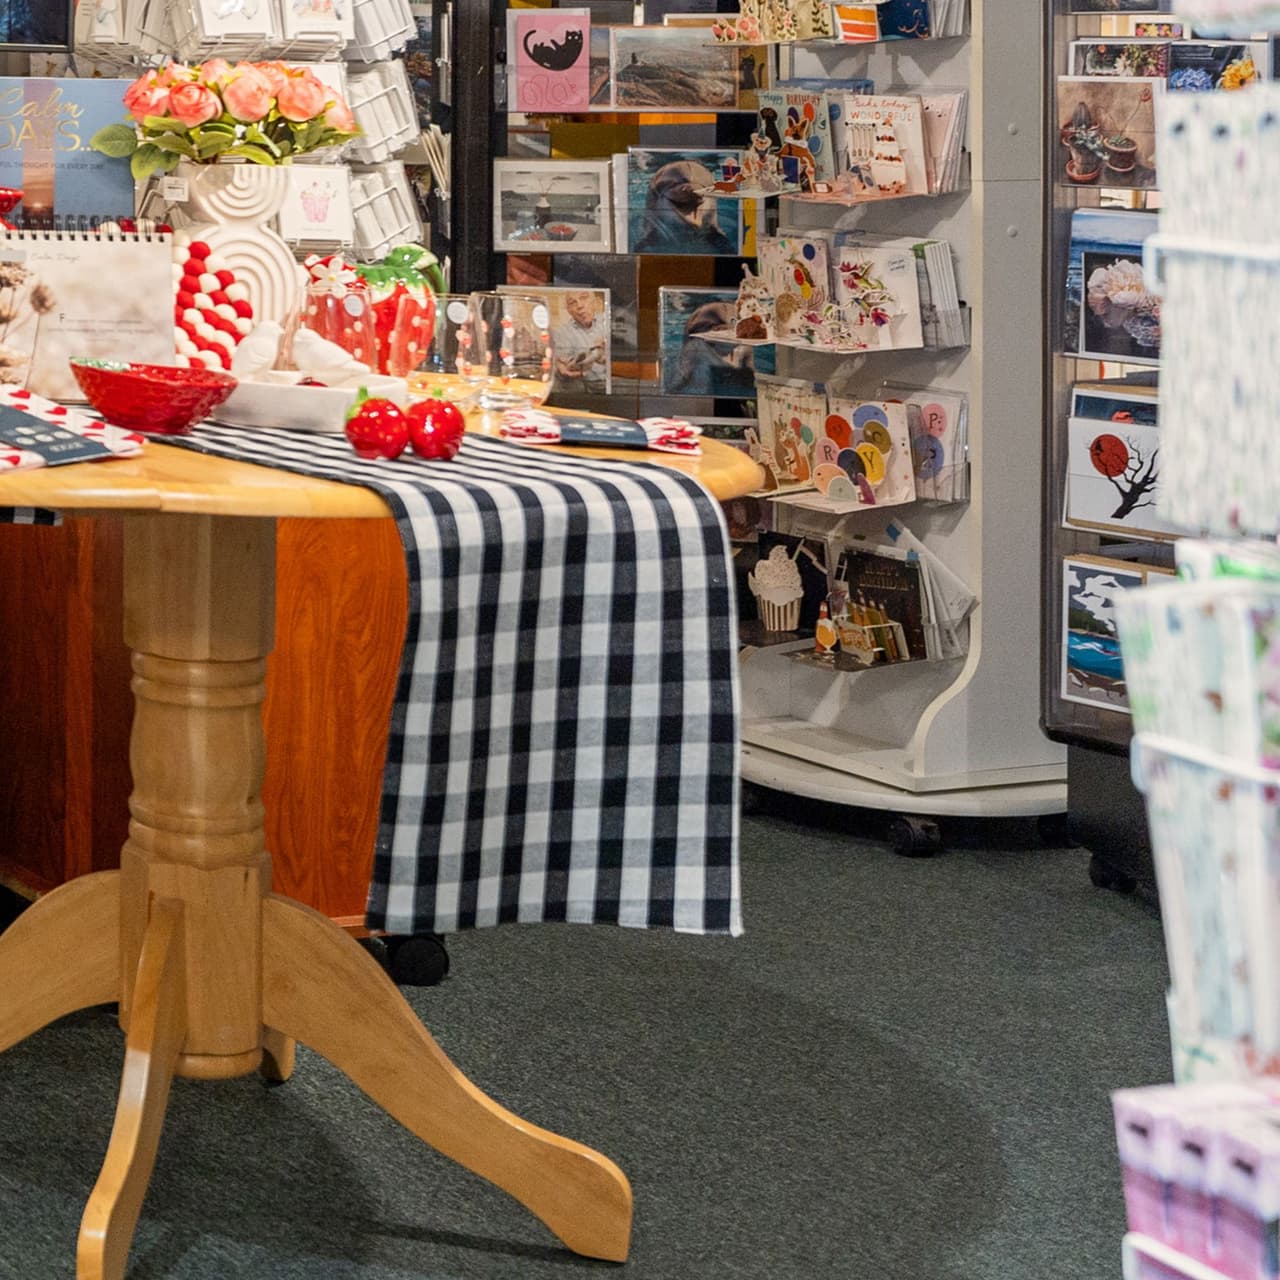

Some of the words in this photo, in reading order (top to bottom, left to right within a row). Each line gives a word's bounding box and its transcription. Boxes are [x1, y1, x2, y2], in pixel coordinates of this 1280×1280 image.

[14, 161, 50, 169] THOUGHT
[51, 162, 66, 170] FOR
[67, 162, 89, 171] EVERY
